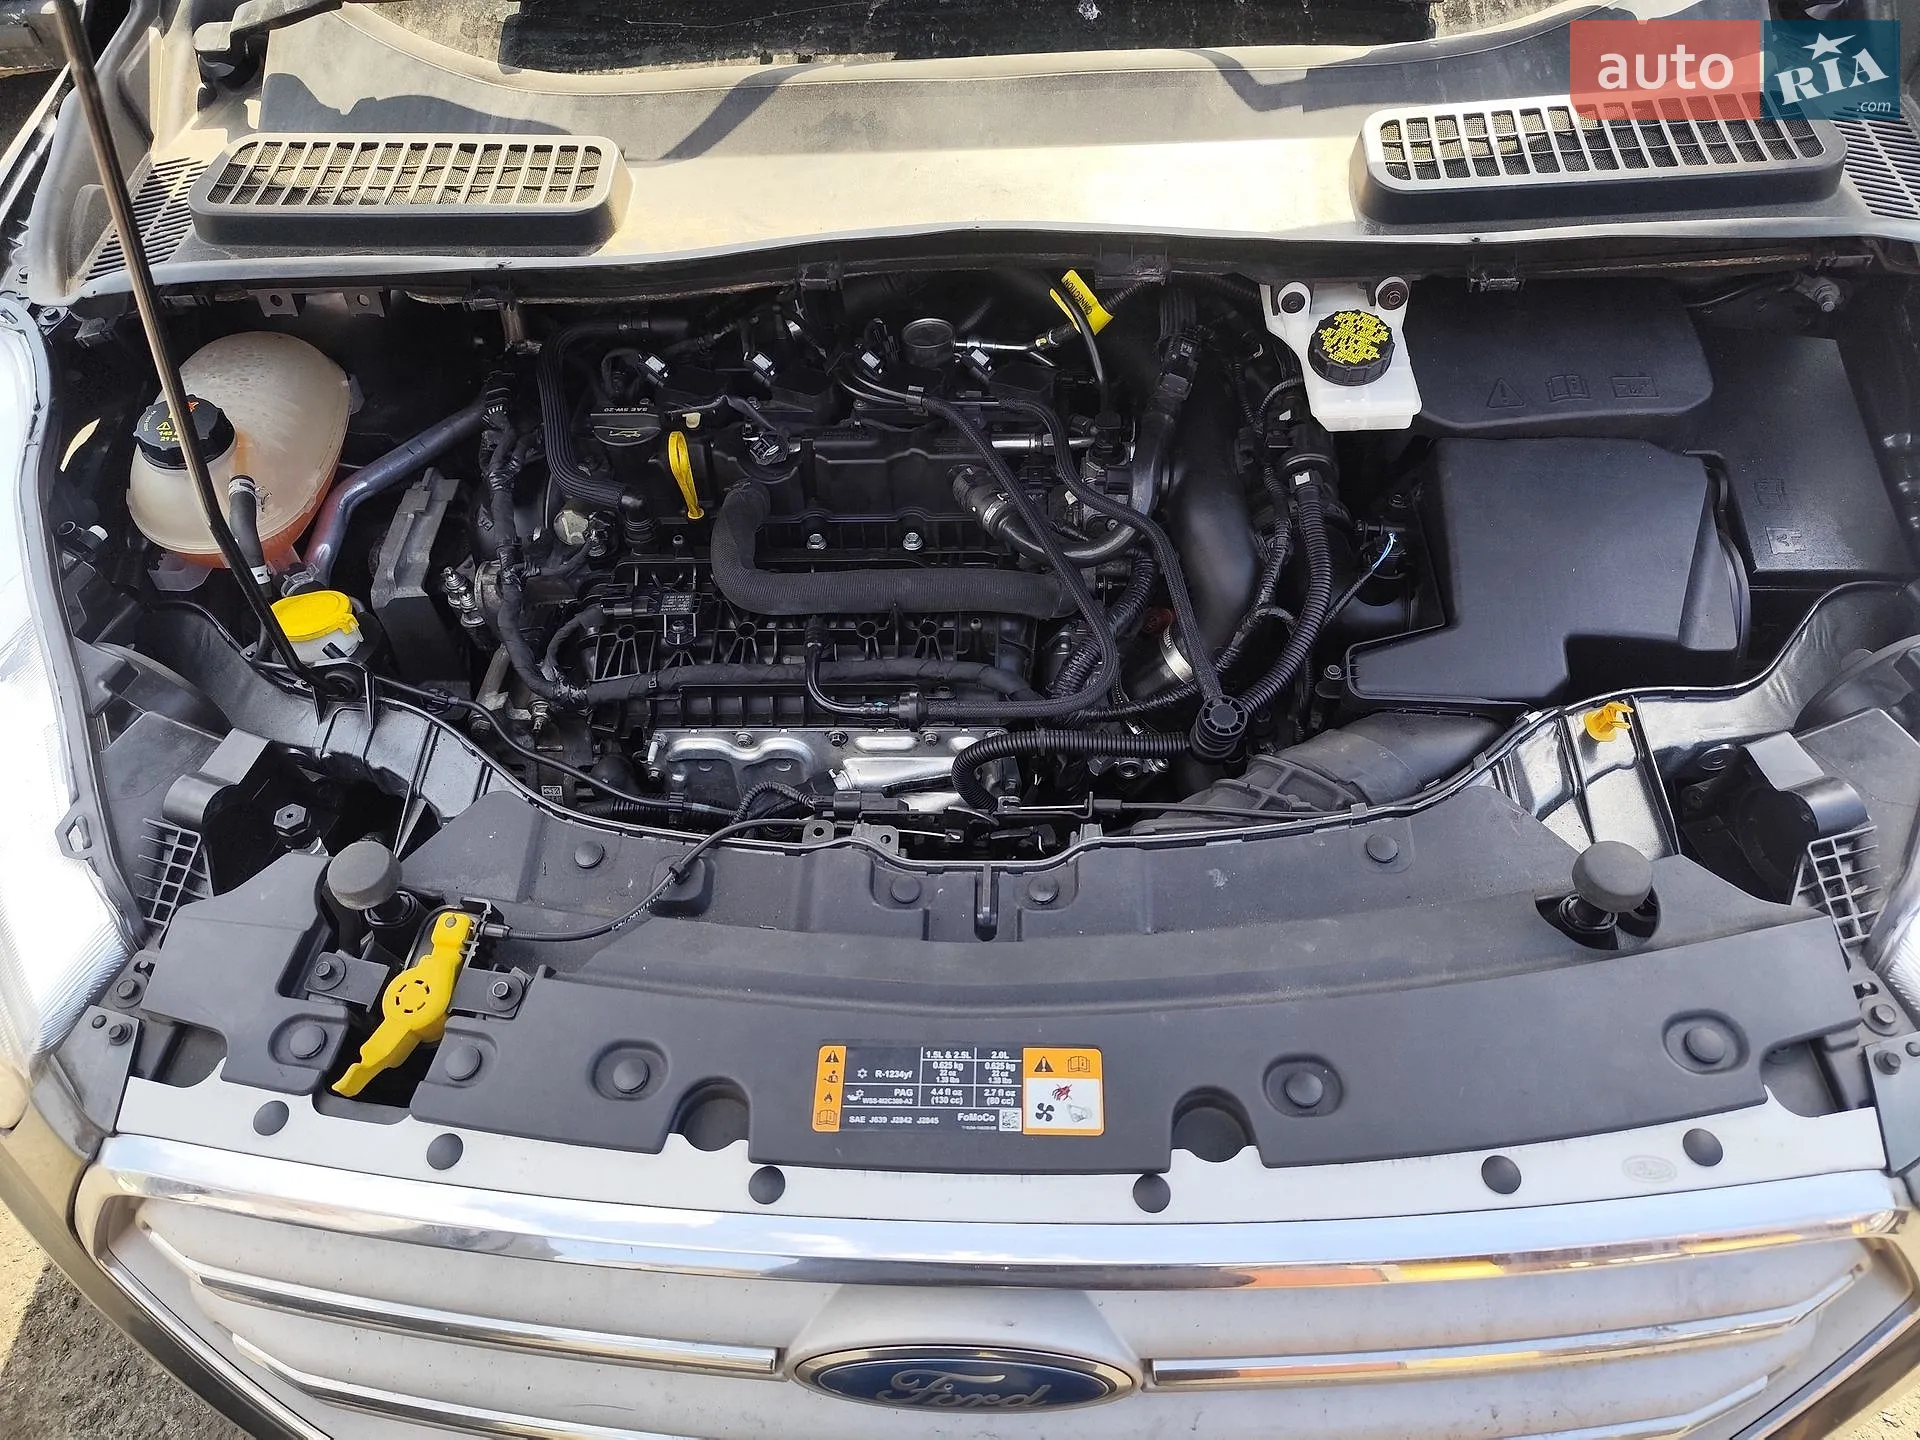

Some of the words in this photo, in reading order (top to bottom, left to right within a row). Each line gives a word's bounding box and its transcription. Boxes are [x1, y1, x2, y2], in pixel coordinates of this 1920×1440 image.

[954, 1062, 964, 1071] kg
[1006, 1062, 1016, 1071] kg
[875, 1070, 912, 1080] R-1234yf
[958, 1113, 995, 1121] FoMoCo
[876, 1368, 1052, 1409] Ford
